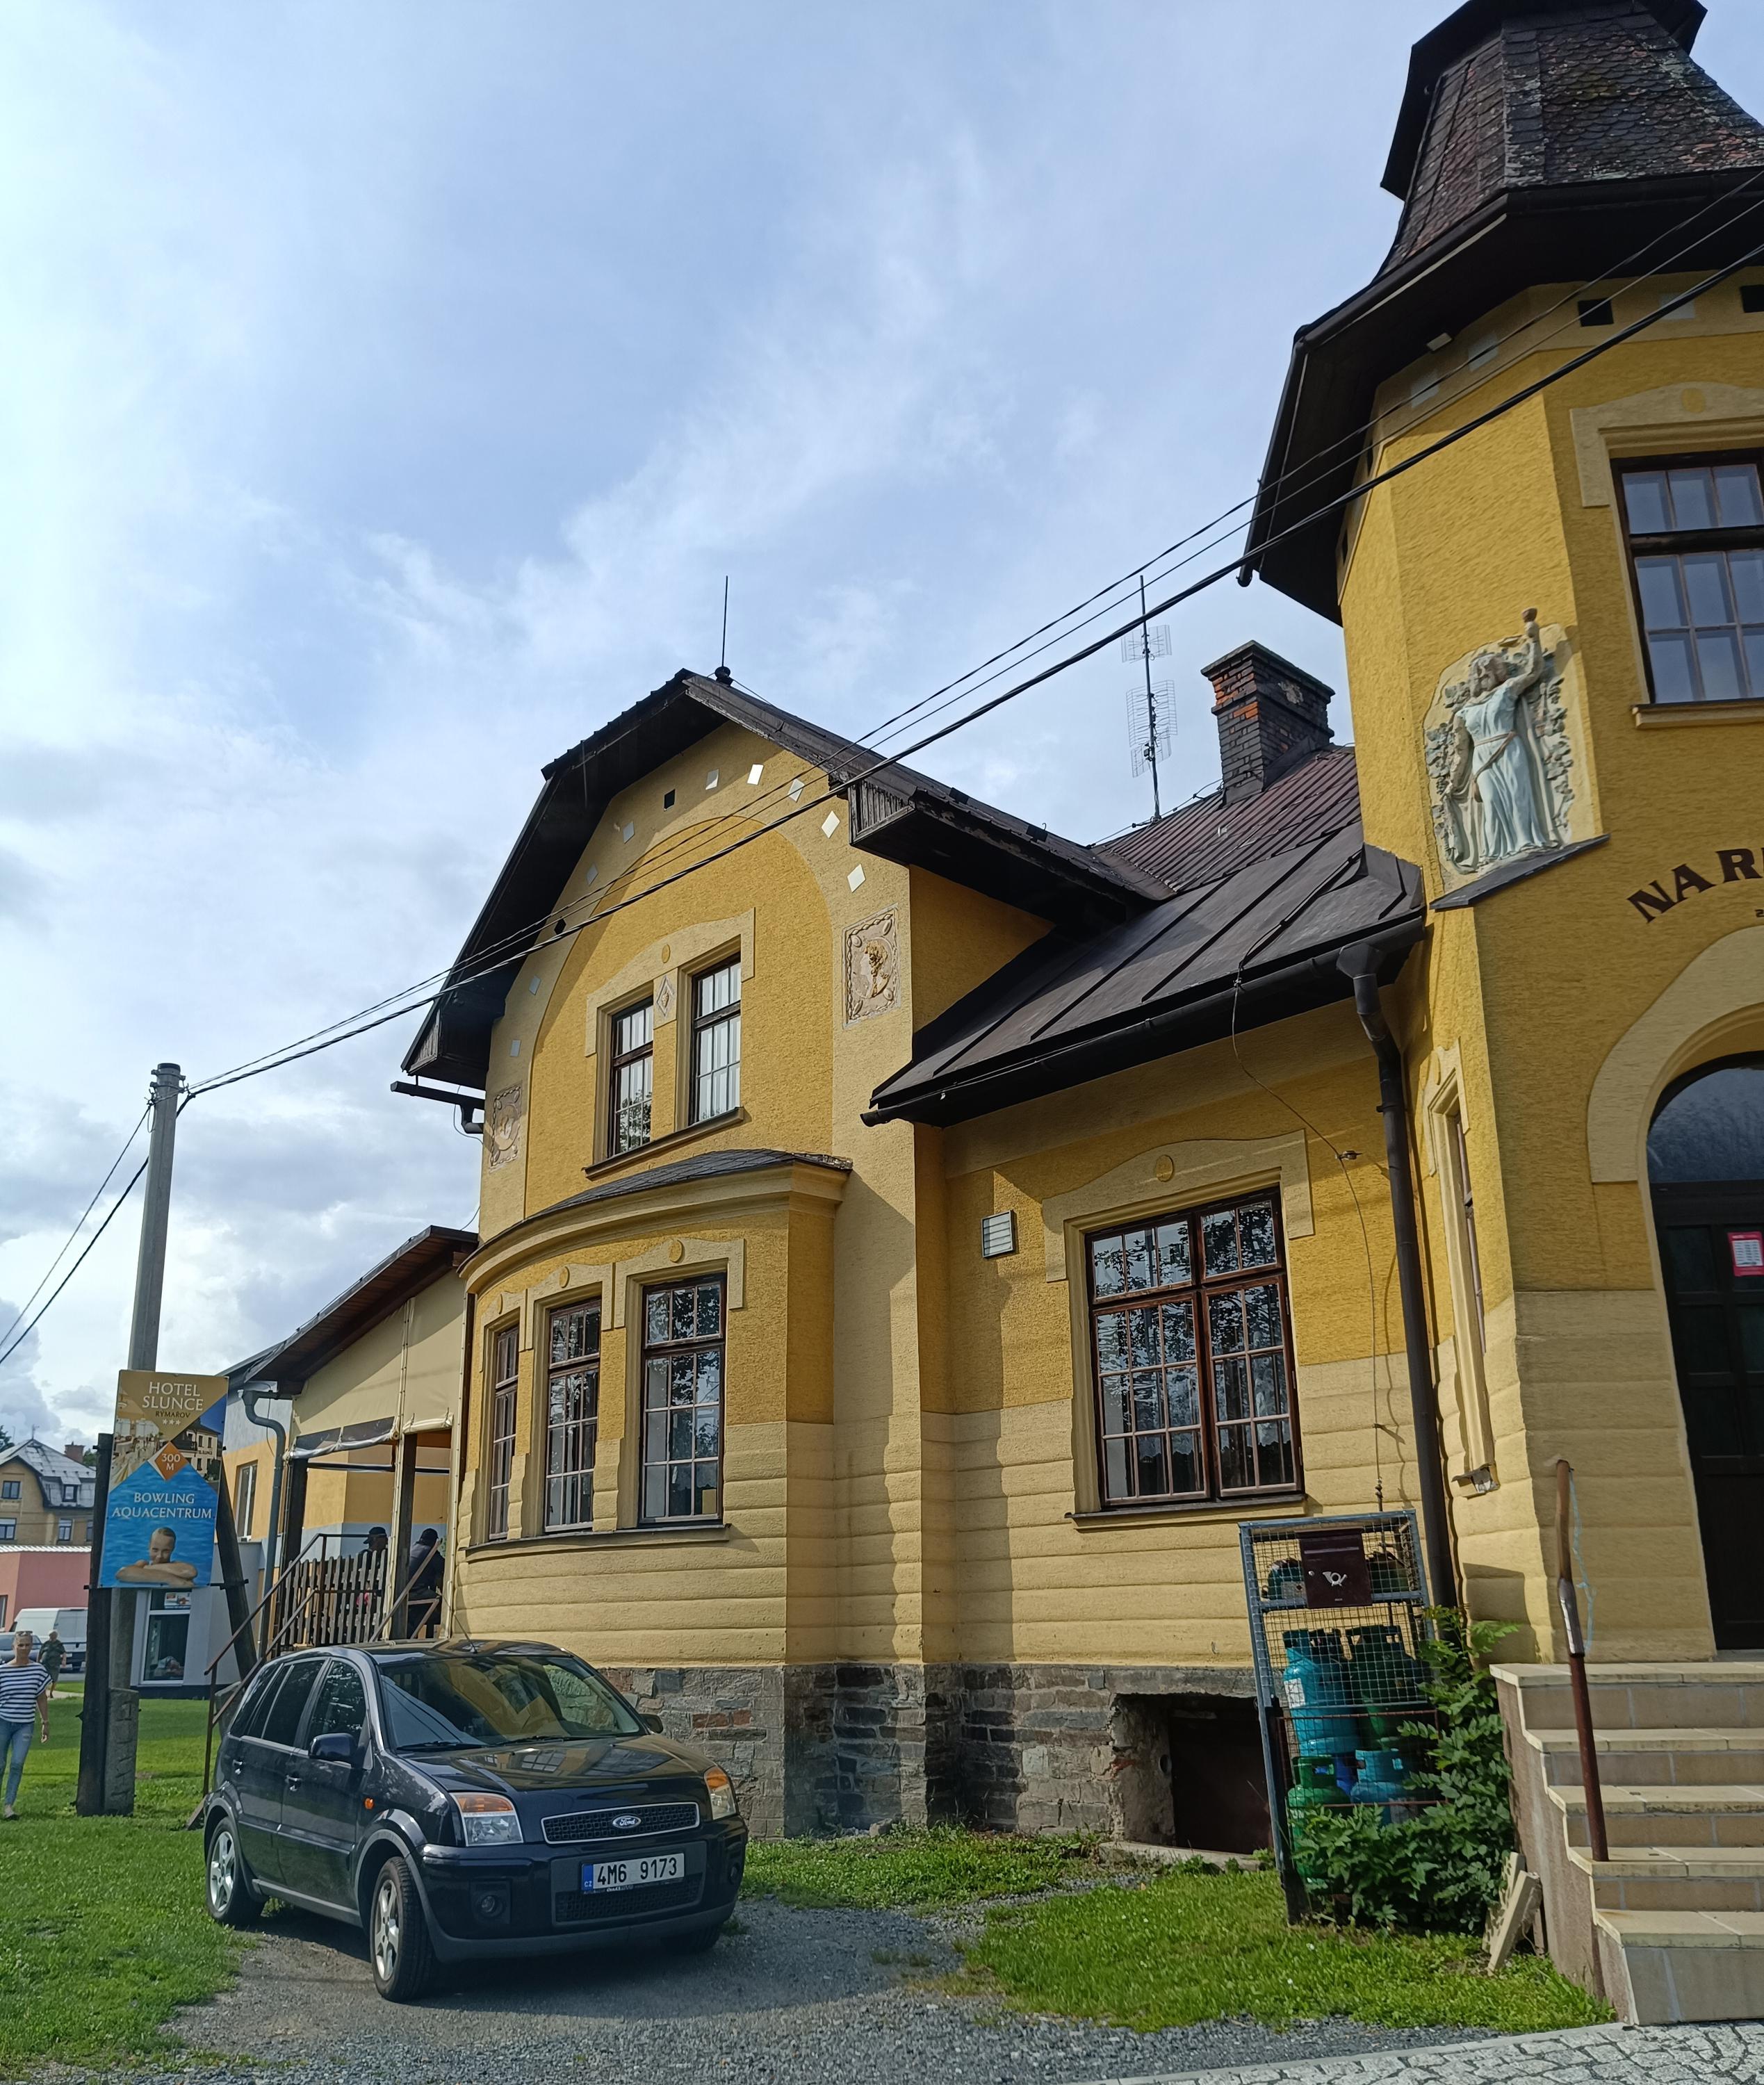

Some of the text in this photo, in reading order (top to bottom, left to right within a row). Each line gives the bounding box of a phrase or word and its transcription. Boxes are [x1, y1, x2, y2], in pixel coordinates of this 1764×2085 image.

[149, 1381, 200, 1396] HOTEL
[142, 1396, 203, 1411] SLUNCE
[162, 1453, 181, 1462] 300
[166, 1463, 174, 1471] M
[134, 1492, 195, 1504] BOWLING
[112, 1506, 212, 1519] AQUACENTRUM
[597, 1857, 677, 1885] 4M6 9173
